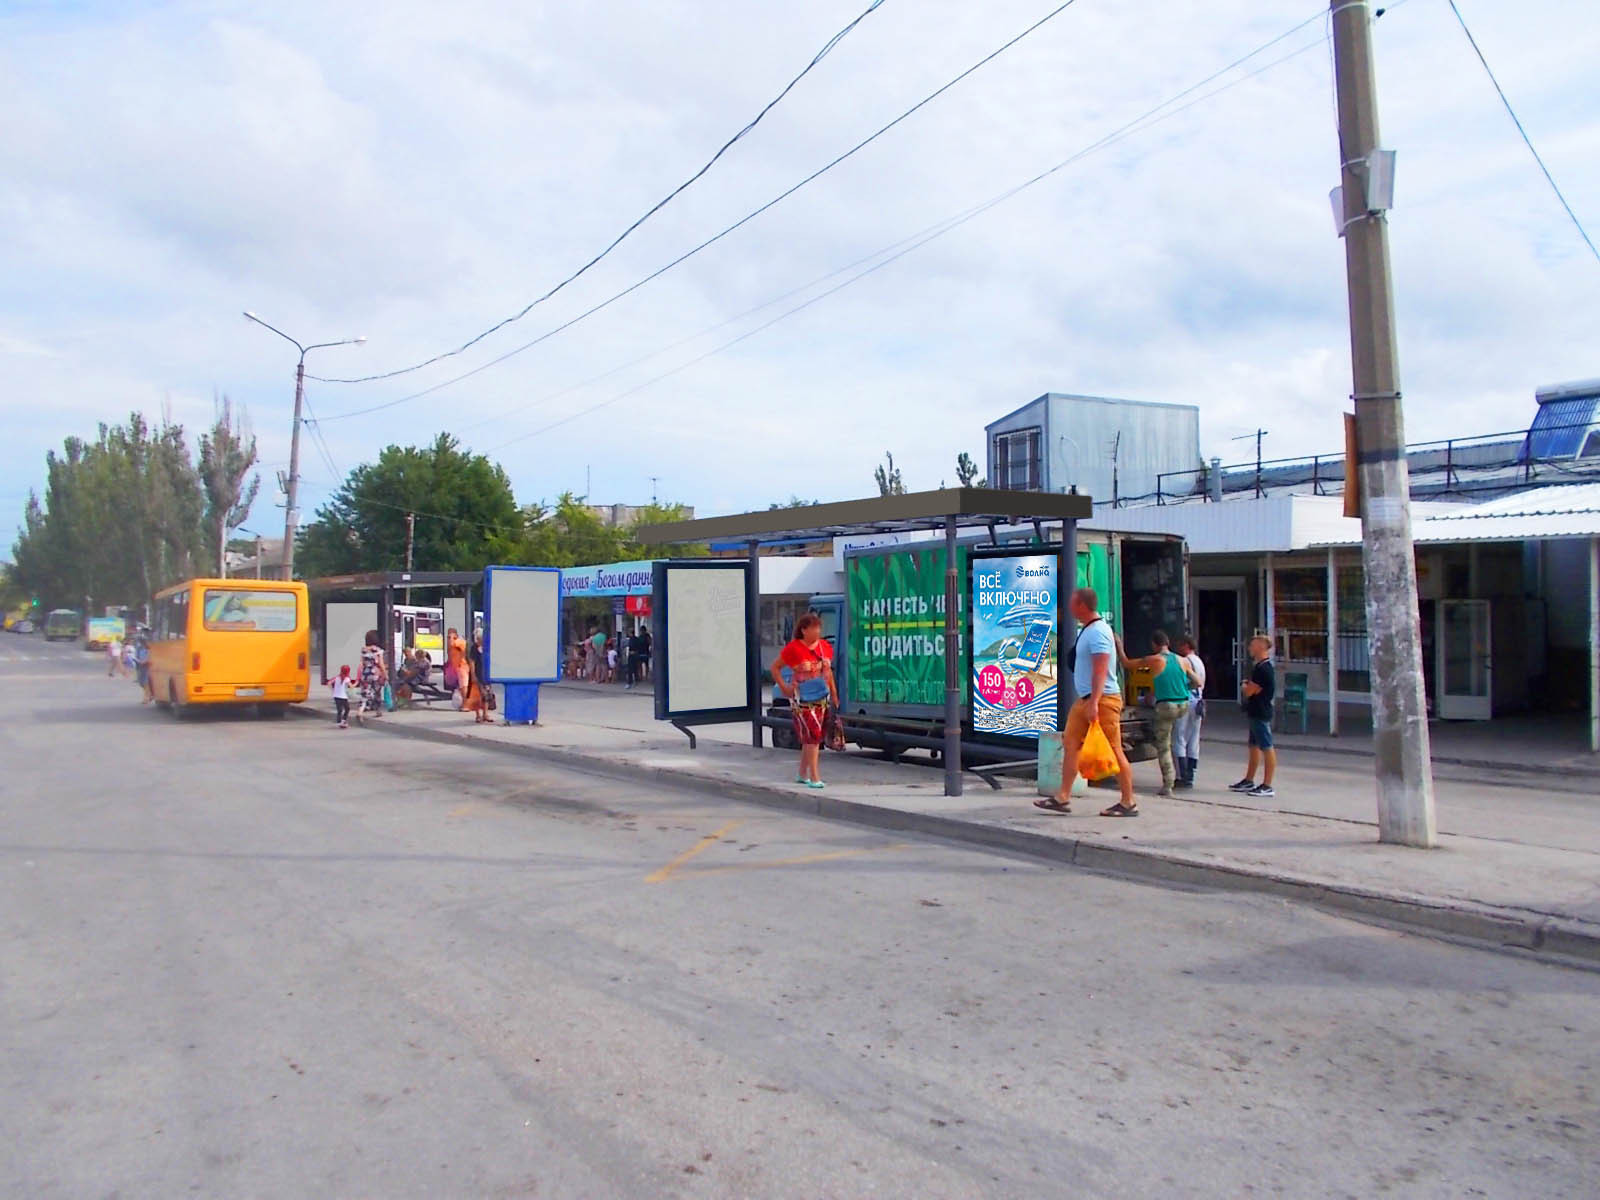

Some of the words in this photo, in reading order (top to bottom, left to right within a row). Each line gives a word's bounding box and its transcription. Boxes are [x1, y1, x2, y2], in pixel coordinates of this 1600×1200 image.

[979, 571, 1002, 589] ВСЁ
[864, 599, 890, 617] НАМ
[894, 595, 928, 615] ЕСТЬ
[979, 590, 1051, 606] ВКЛЮЧЕНО
[864, 635, 963, 660] ГОРДИТЬС!
[982, 672, 1001, 687] 150
[1018, 682, 1027, 697] 3
